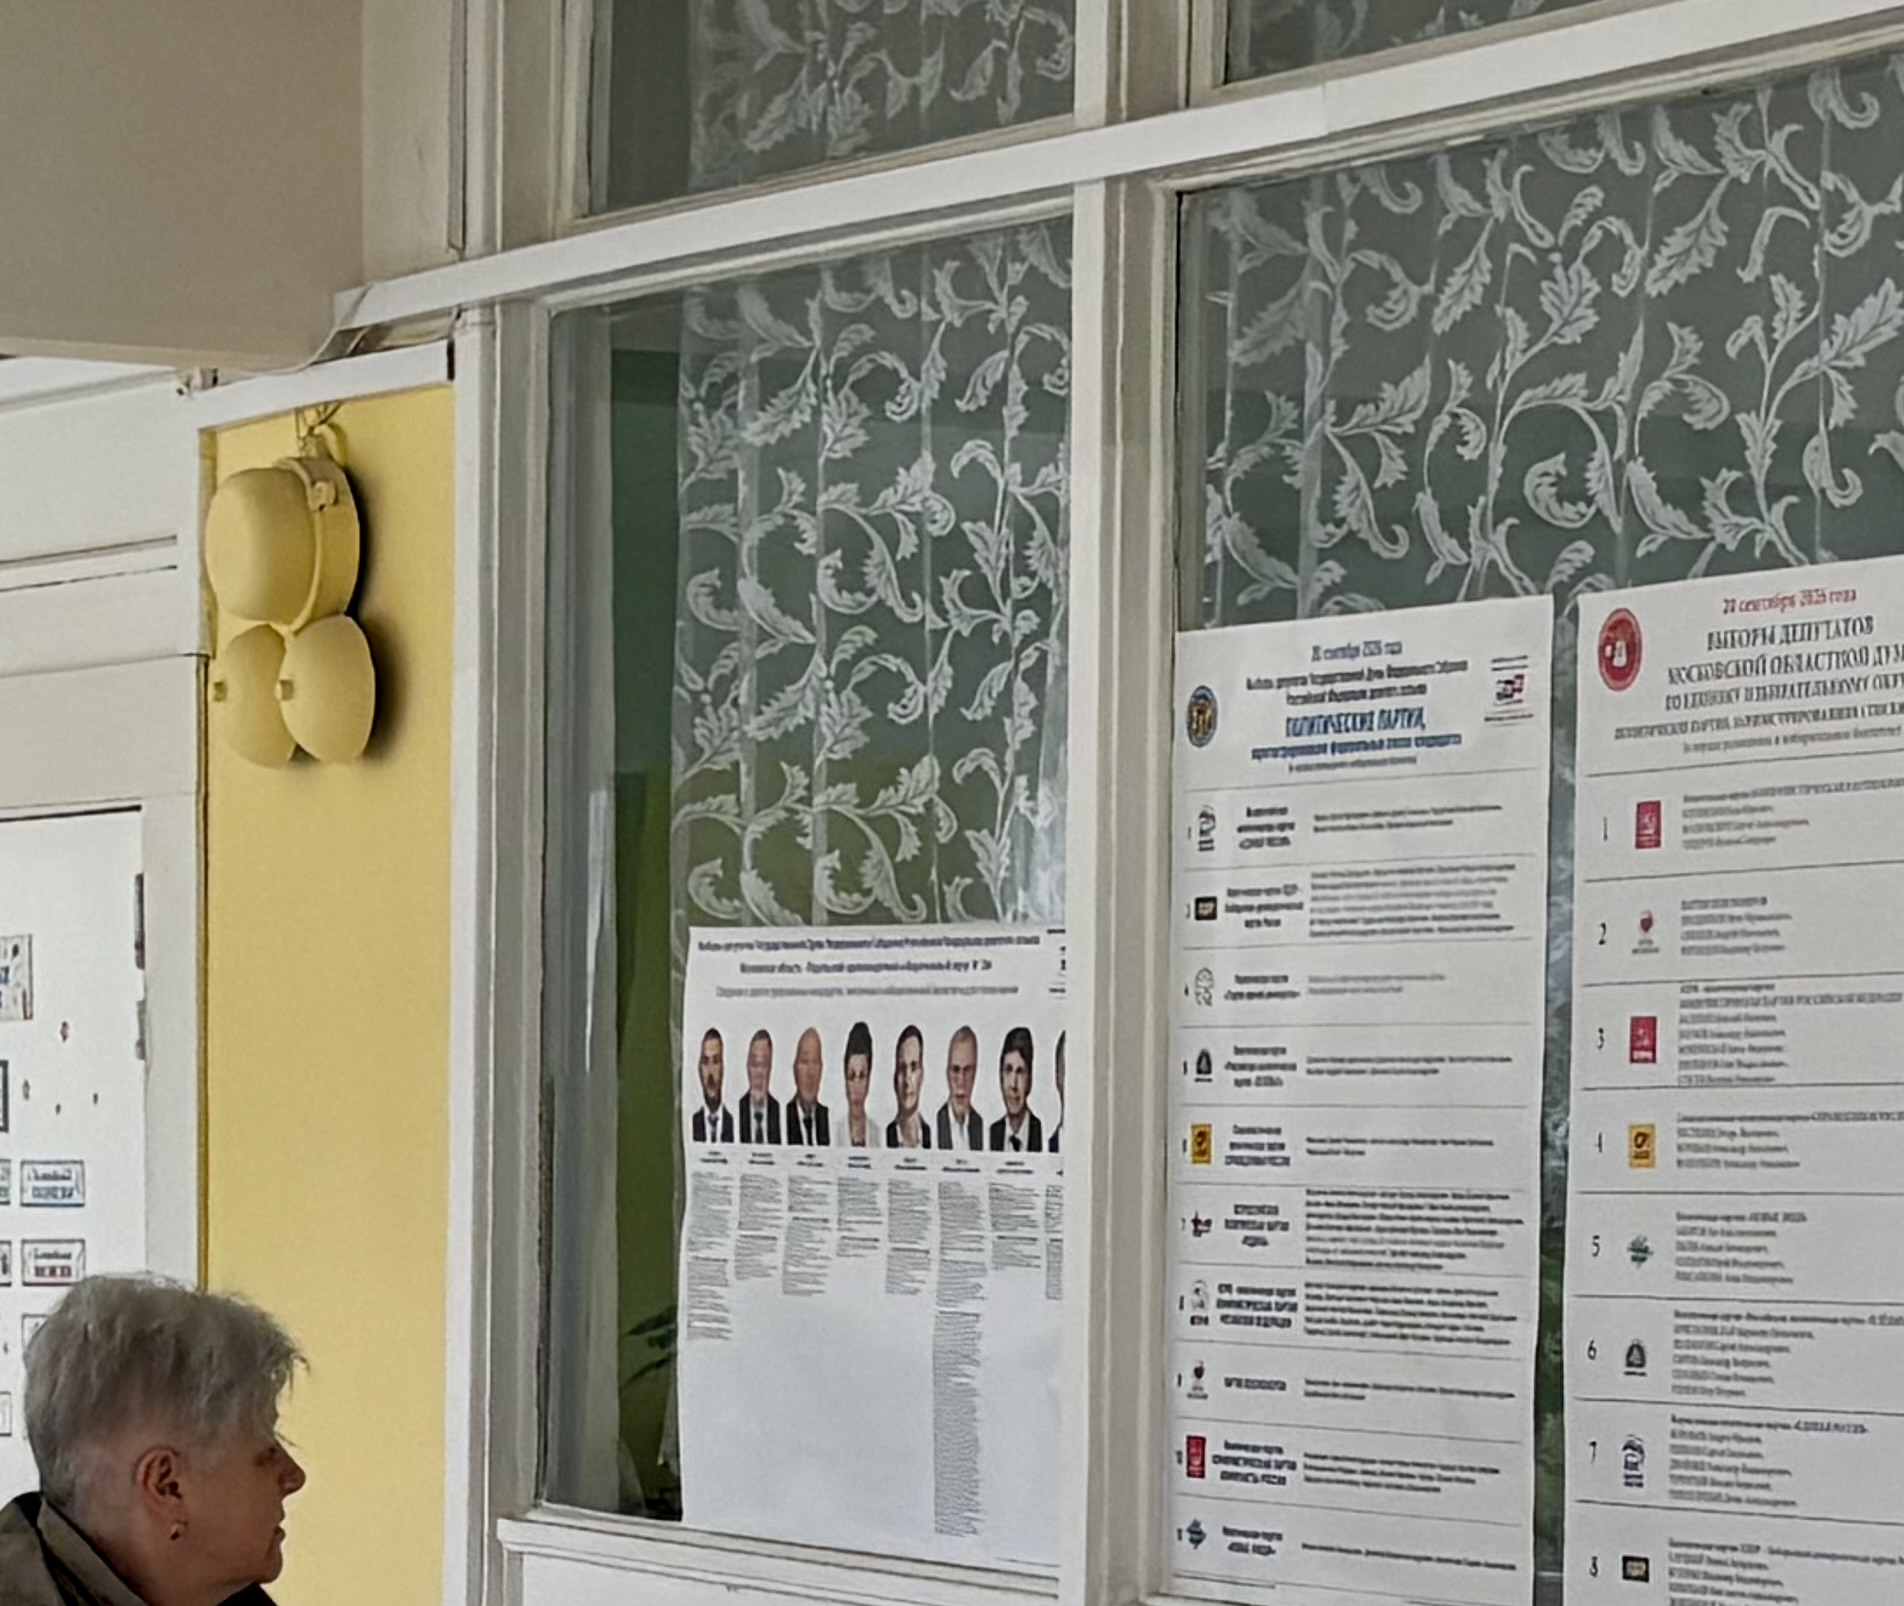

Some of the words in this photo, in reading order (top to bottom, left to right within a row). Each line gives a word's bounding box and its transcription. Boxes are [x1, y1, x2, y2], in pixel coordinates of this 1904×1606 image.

[1598, 922, 1608, 946] 2
[1597, 1027, 1605, 1050] 3
[1591, 1235, 1601, 1258] 5
[1587, 1340, 1598, 1361] 6
[1589, 1440, 1598, 1465] 7
